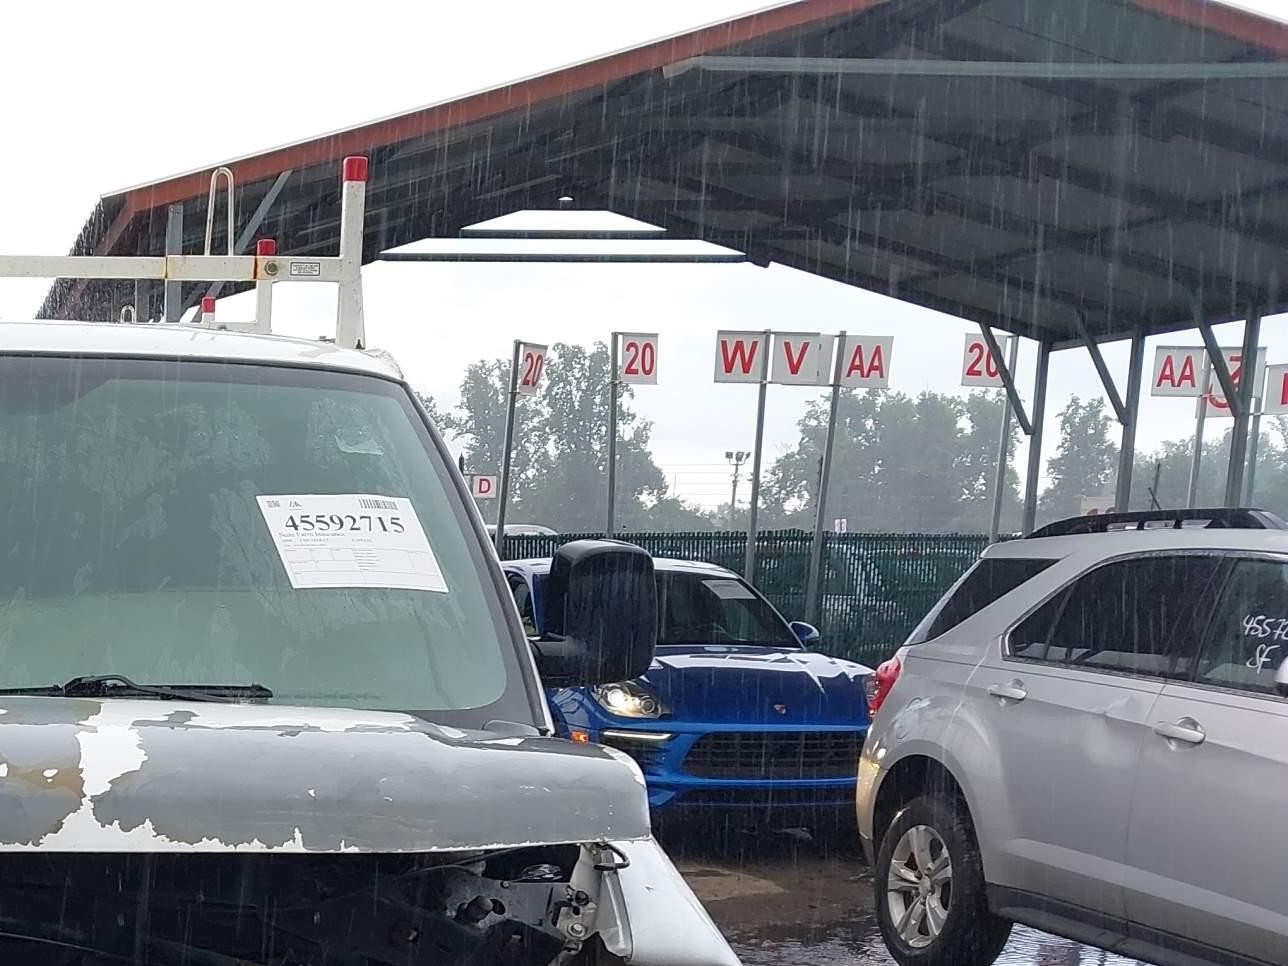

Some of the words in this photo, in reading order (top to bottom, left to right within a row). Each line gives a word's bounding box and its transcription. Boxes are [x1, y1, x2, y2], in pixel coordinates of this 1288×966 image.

[522, 352, 544, 387] 20
[624, 341, 655, 376] 20
[720, 339, 759, 374] W
[783, 341, 810, 375] V
[845, 344, 885, 379] AA
[1156, 354, 1197, 388] AA
[478, 478, 491, 494] D
[285, 514, 405, 534] 45592715
